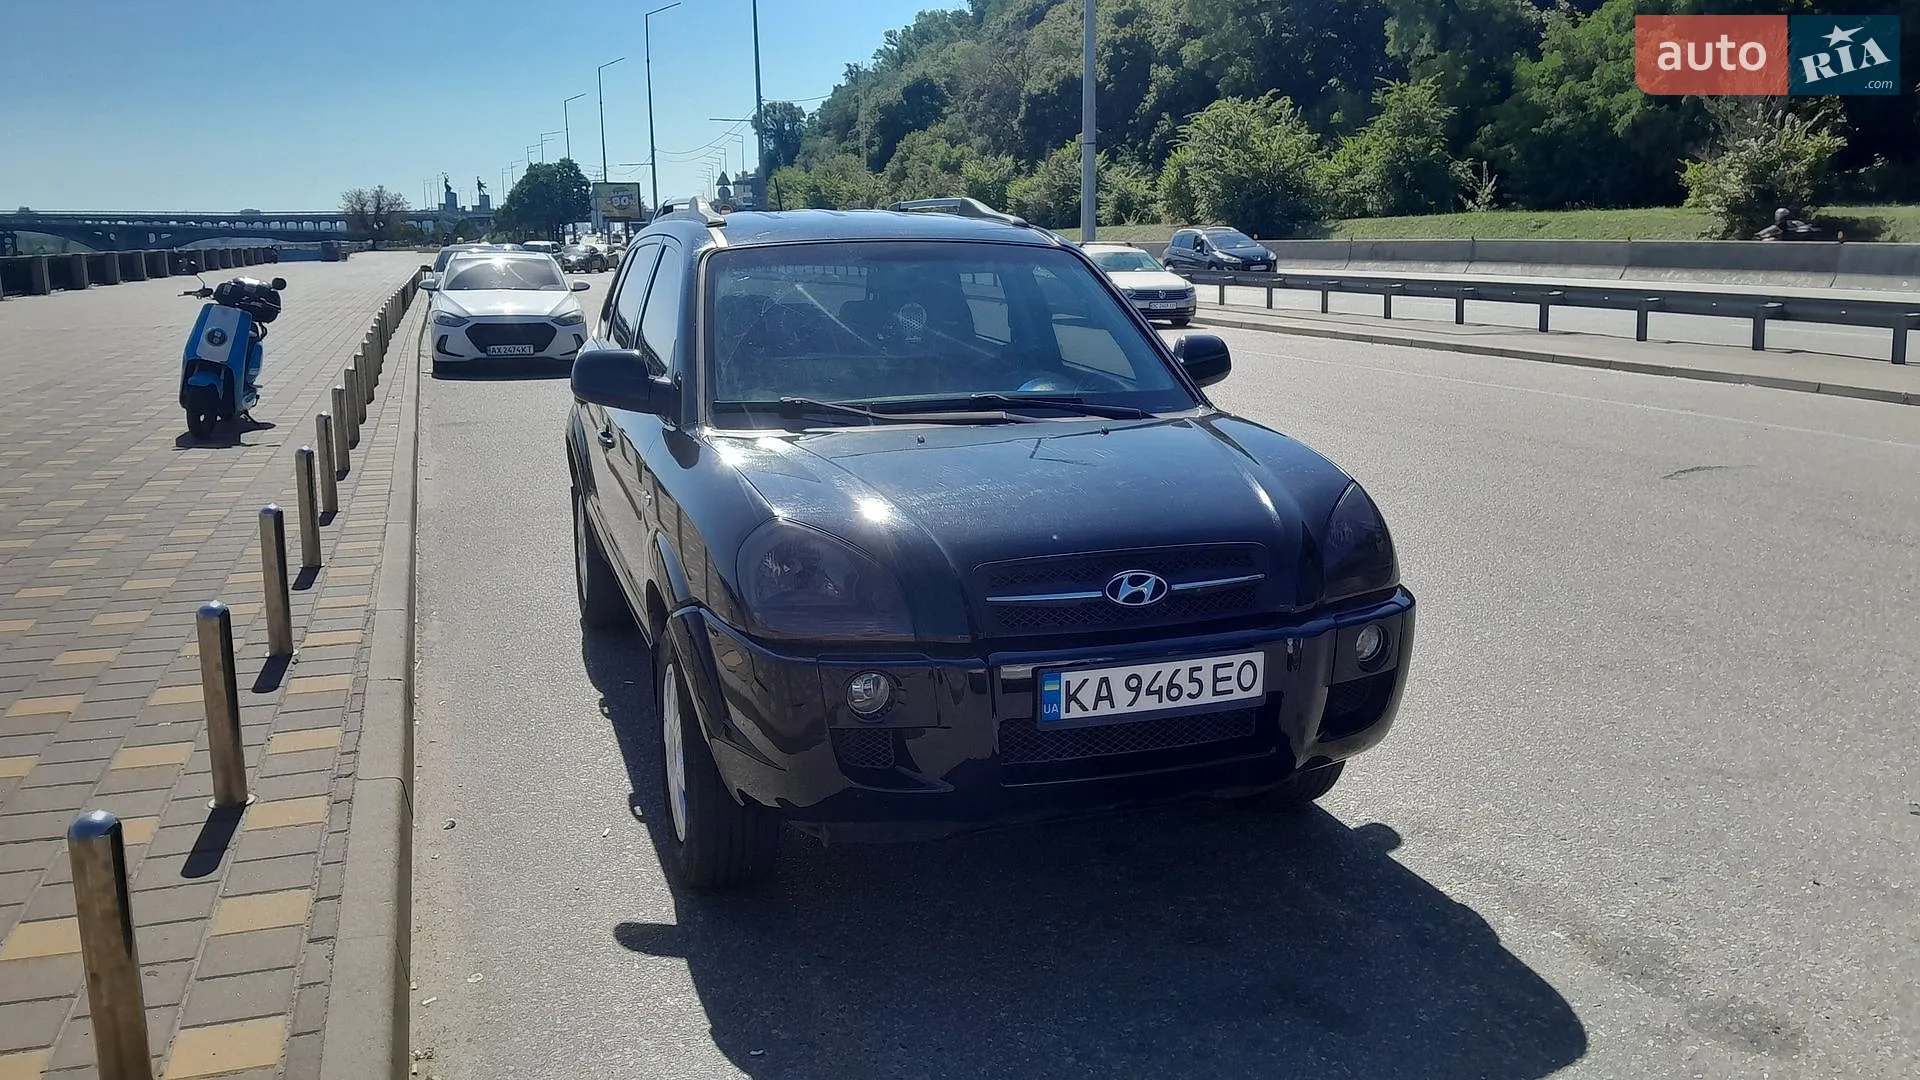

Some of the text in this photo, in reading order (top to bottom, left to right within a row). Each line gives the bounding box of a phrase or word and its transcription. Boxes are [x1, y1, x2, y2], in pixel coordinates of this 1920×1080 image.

[1064, 659, 1258, 714] KA 9465 EO
[1043, 703, 1059, 714] UA
